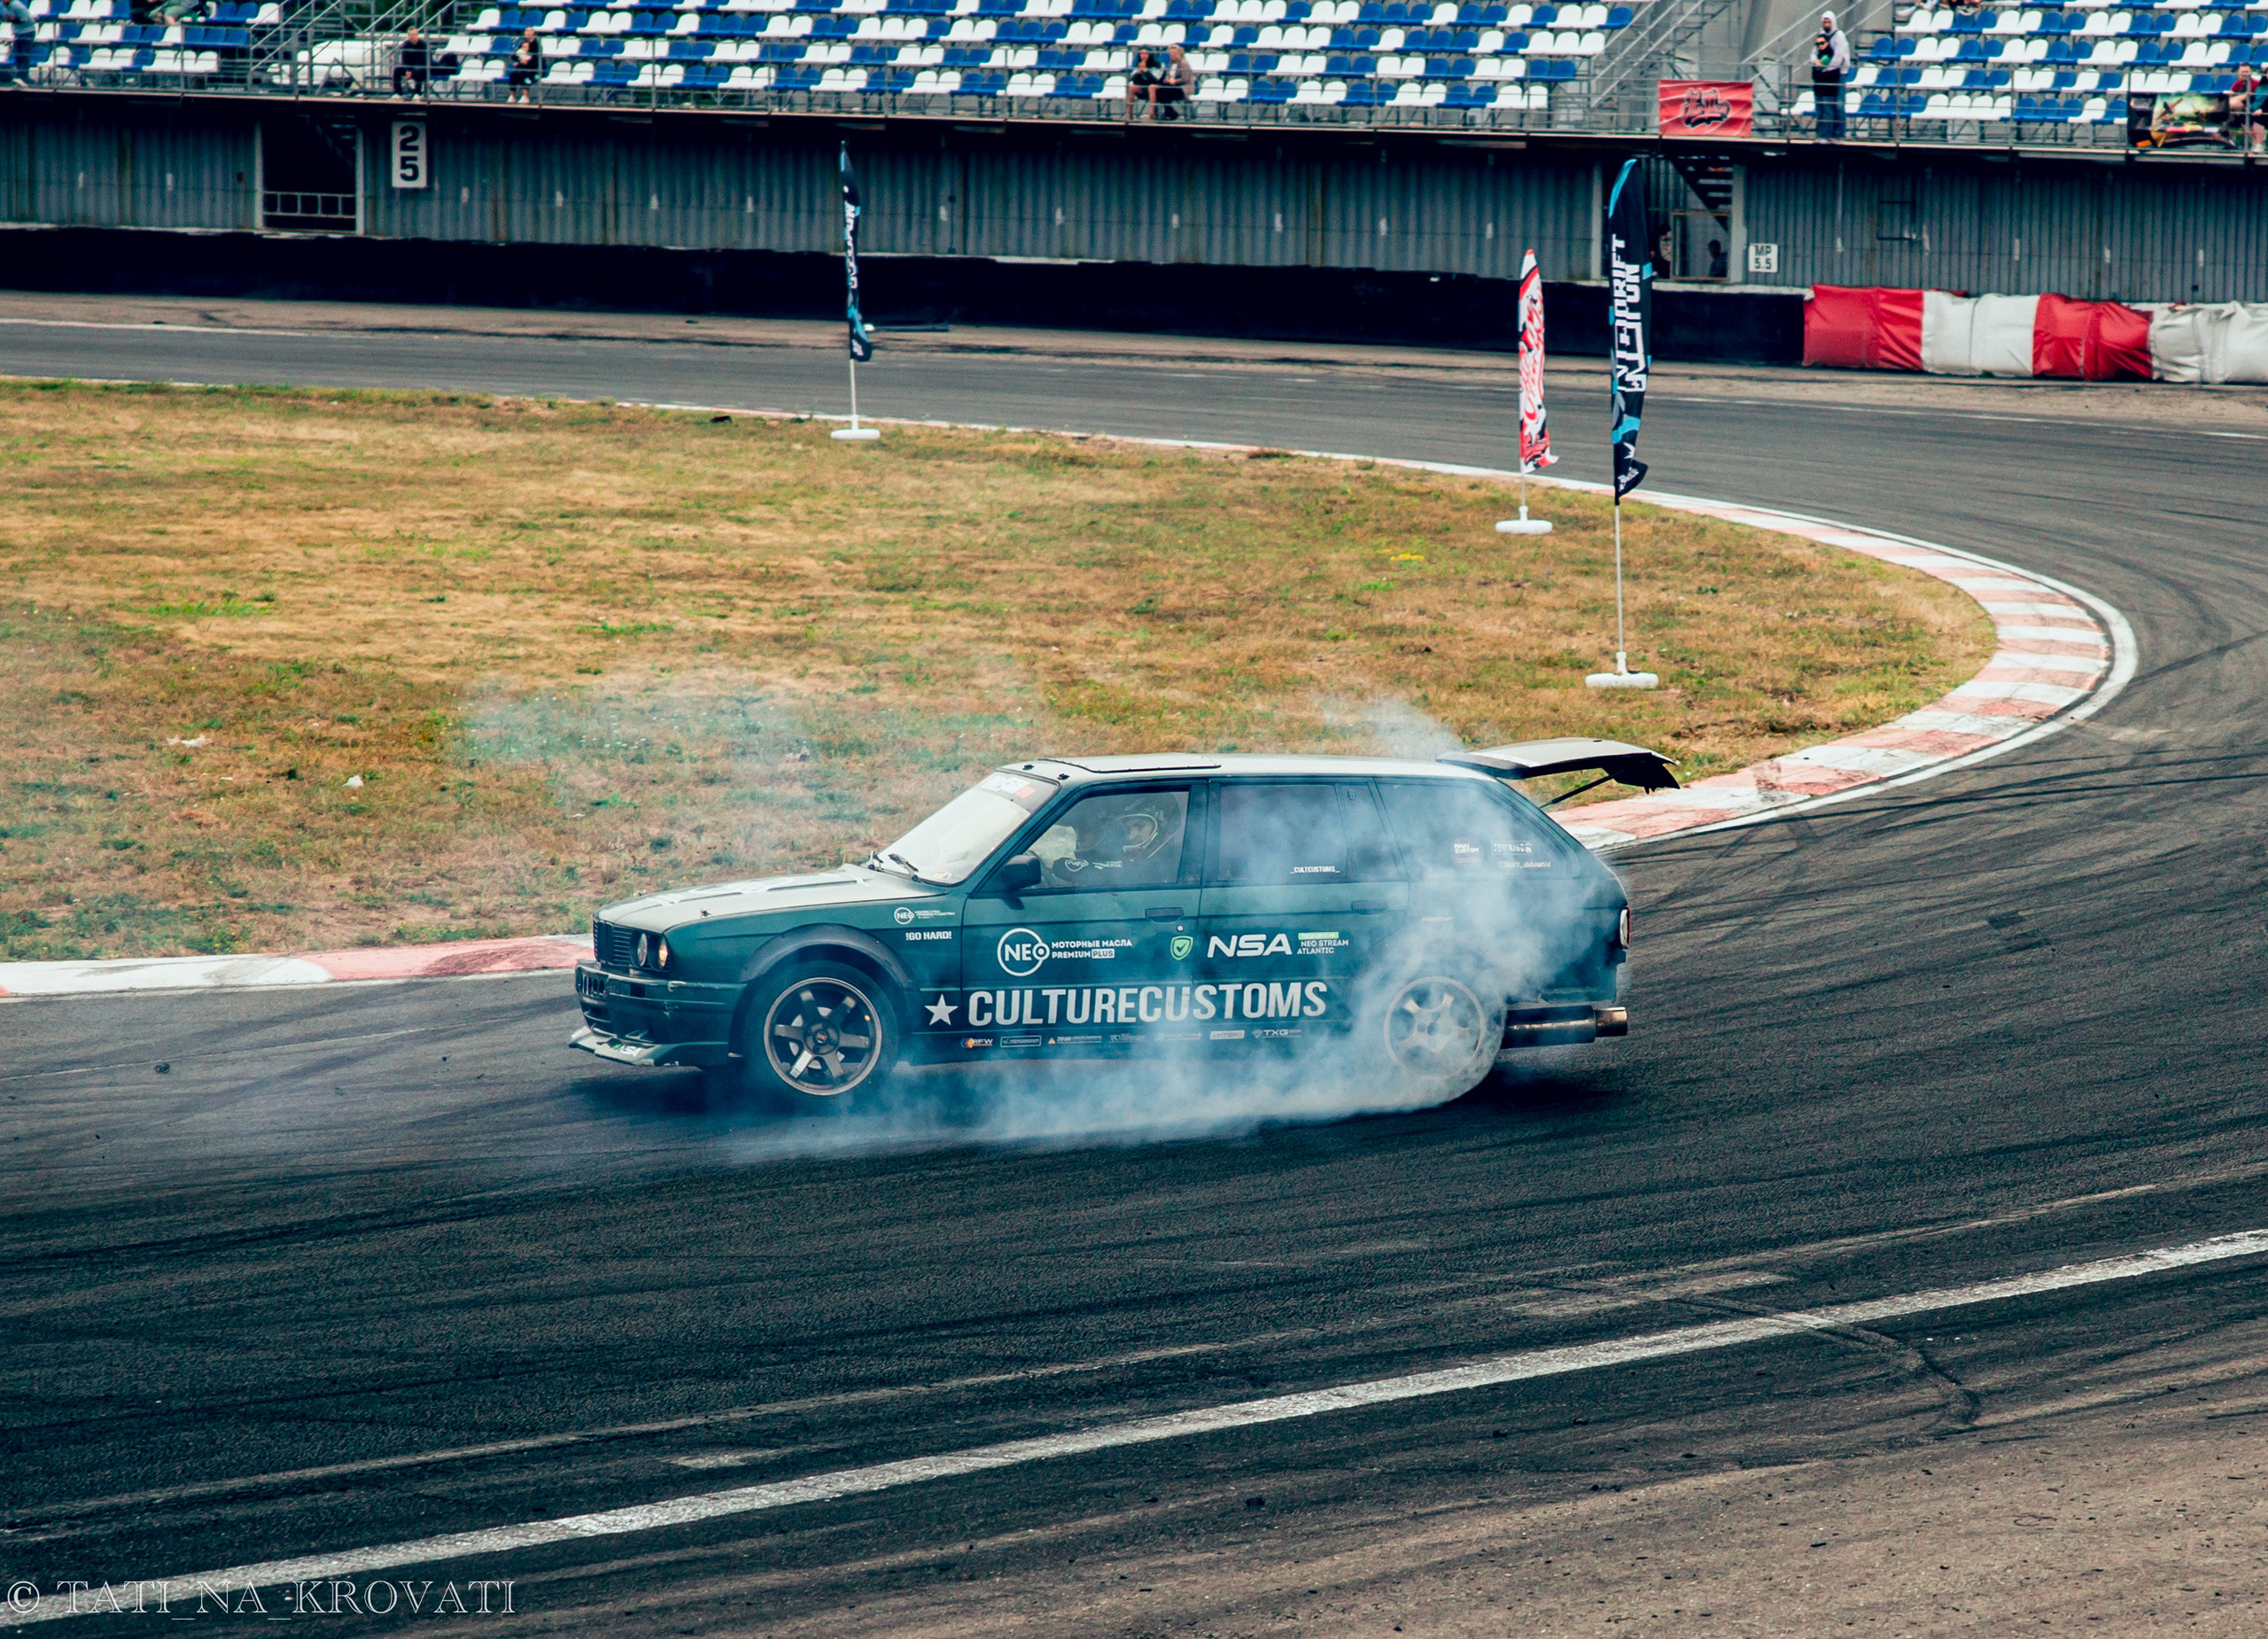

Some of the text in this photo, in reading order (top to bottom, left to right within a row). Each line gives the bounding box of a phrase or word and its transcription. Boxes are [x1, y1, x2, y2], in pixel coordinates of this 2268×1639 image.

[1755, 245, 1772, 256] MP
[1612, 234, 1627, 317] DRIFT
[905, 930, 952, 941] !GO HARD!
[1051, 938, 1133, 949] МОТОРНЫЕ МАСЛА
[1207, 933, 1293, 959] NSA
[1004, 942, 1051, 962] NEO
[1052, 949, 1091, 959] PREMIUM
[1296, 946, 1335, 955] ATLANTIC
[967, 981, 1328, 1027] CULTURECUSTOMS
